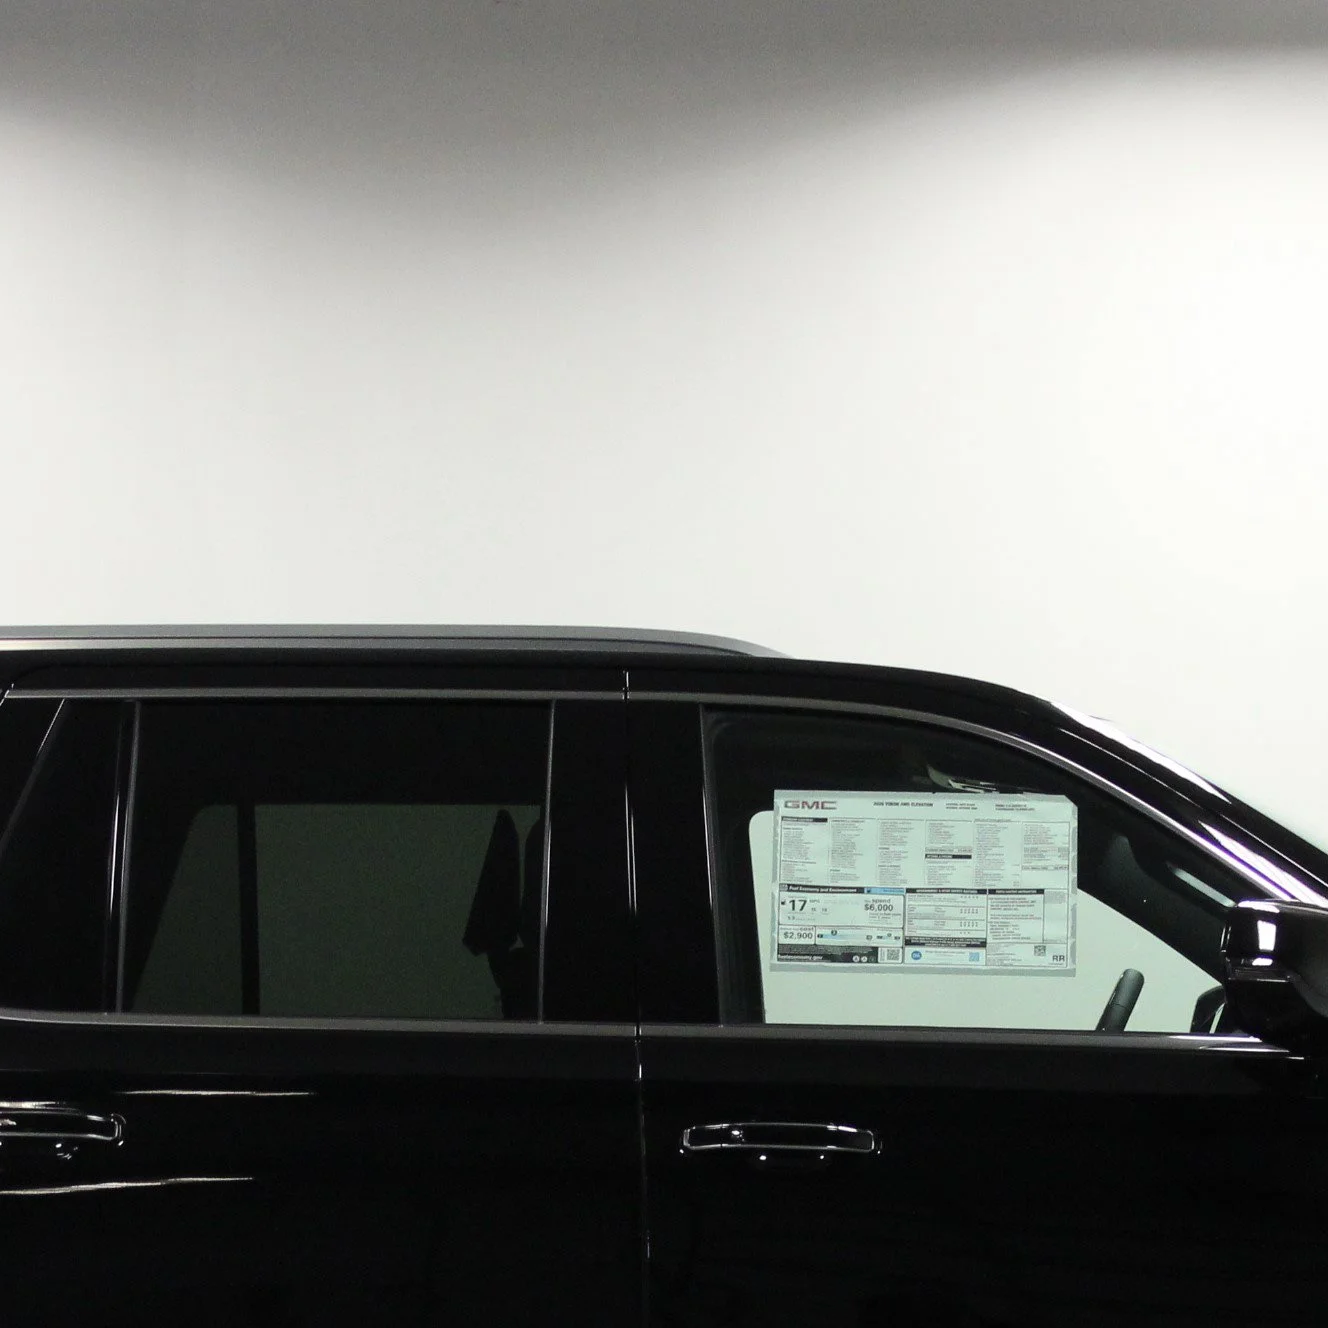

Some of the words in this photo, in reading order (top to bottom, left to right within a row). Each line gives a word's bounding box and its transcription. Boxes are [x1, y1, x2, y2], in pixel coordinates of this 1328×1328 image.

[784, 800, 837, 810] GMC
[789, 899, 807, 911] 17
[864, 903, 894, 912] $6,000
[783, 931, 813, 940] $2,900
